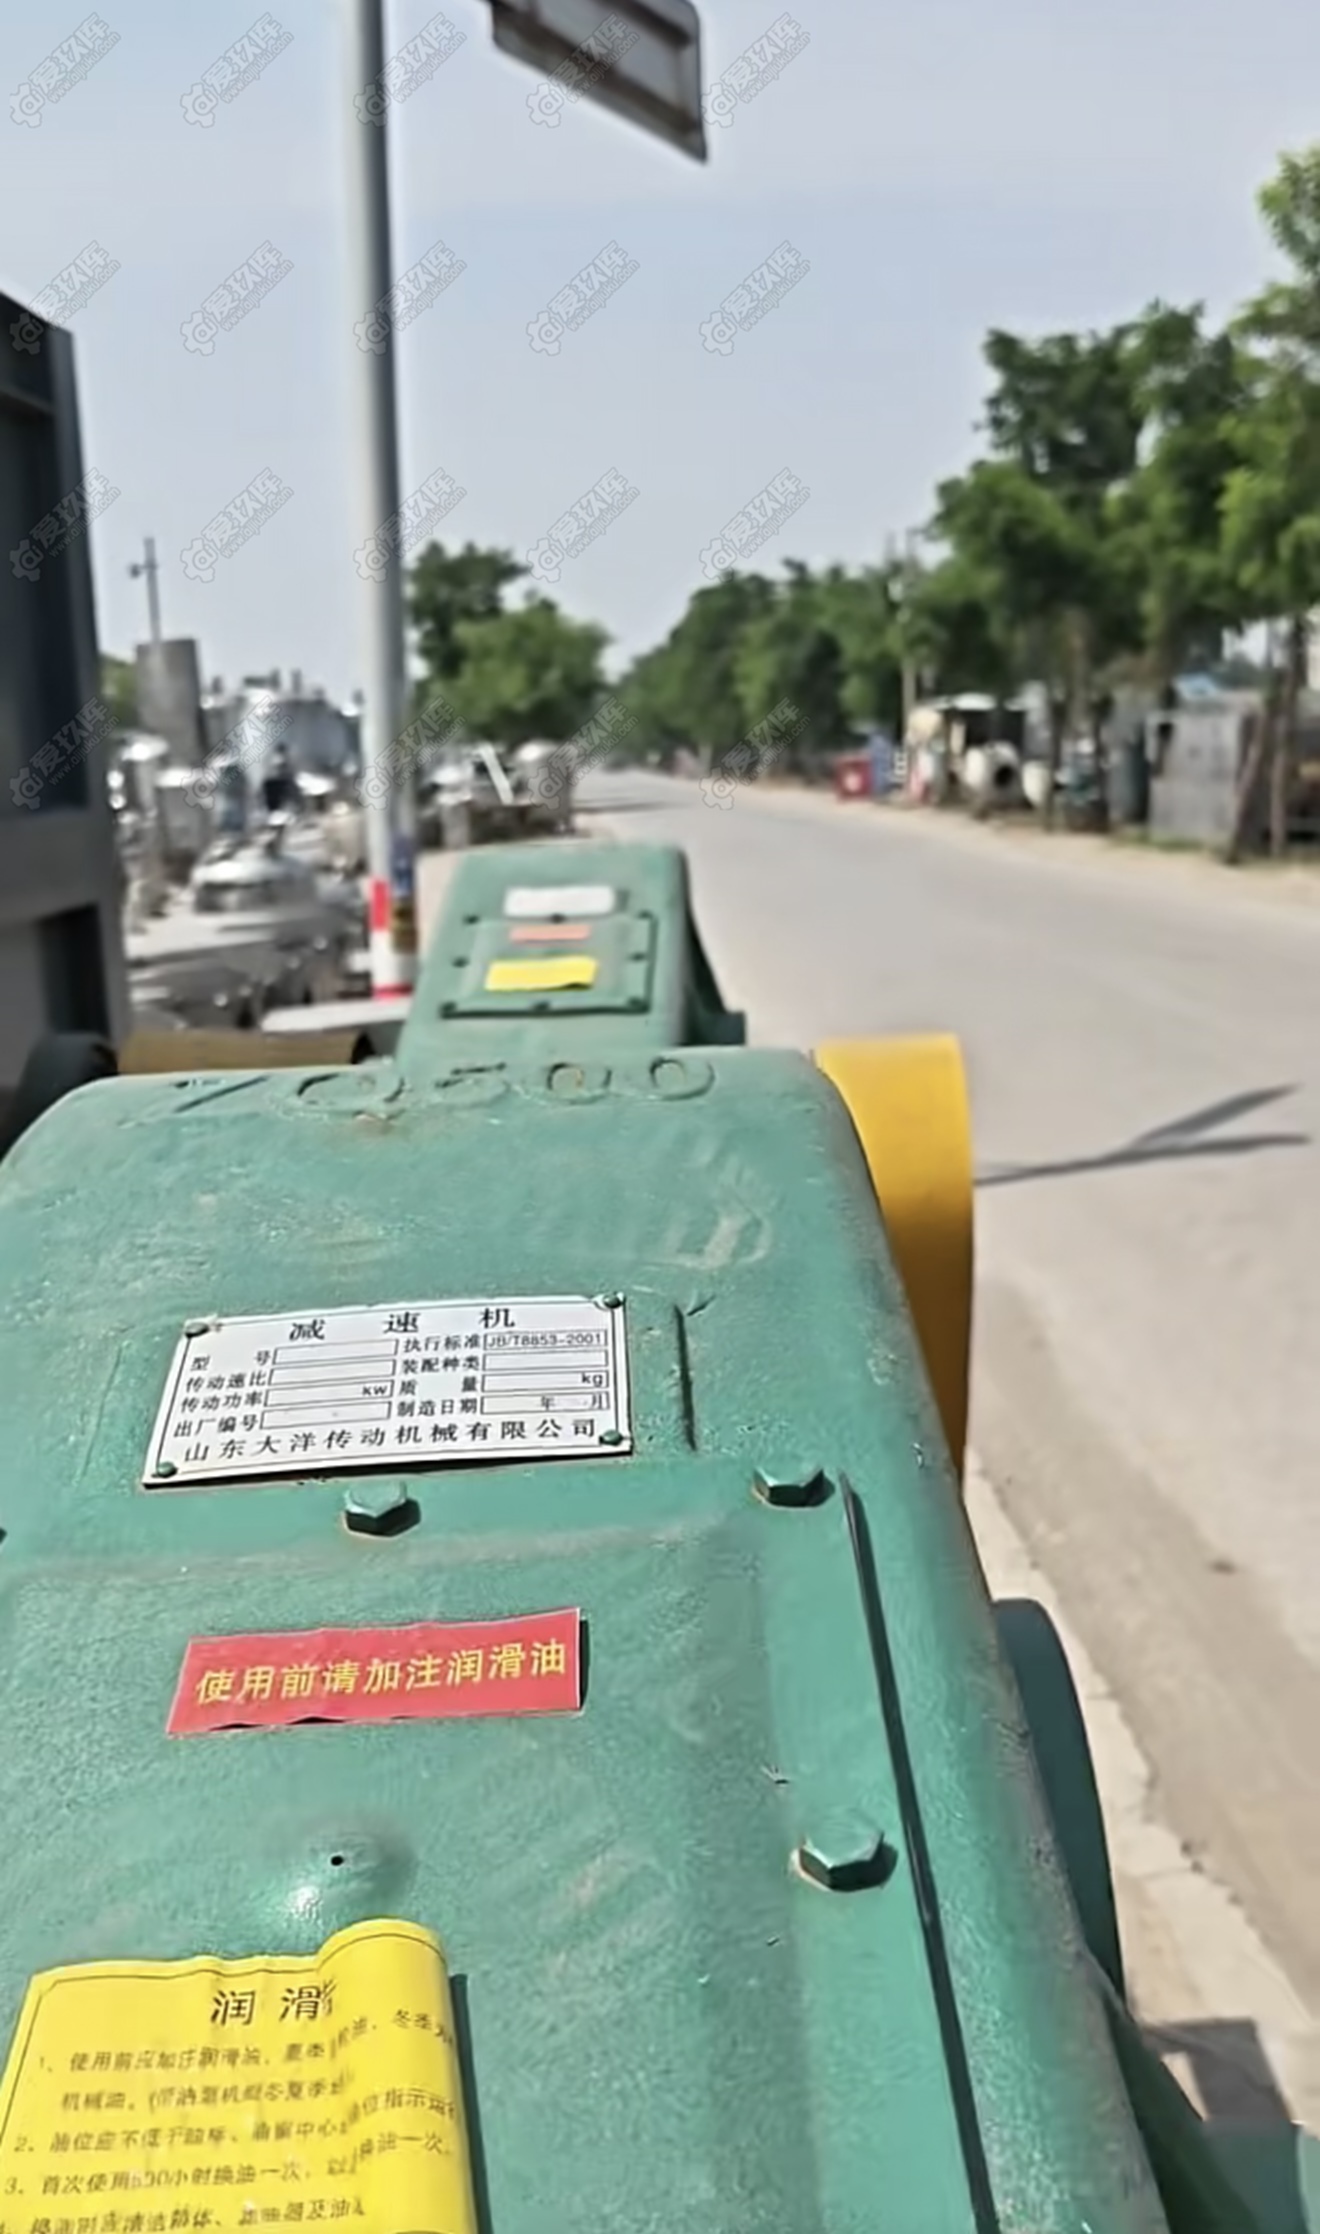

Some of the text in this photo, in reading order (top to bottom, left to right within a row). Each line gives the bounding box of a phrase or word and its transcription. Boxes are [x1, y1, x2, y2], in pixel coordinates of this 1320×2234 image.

[289, 1308, 515, 1341] 减速机
[404, 1333, 480, 1353] 执行标准
[488, 1334, 601, 1348] JB/T8853-2001
[402, 1356, 480, 1375] 装配种类
[186, 1372, 267, 1393] 传动速比
[581, 1372, 604, 1388] kg
[181, 1391, 263, 1413] 传动功率
[397, 1398, 478, 1418] 制造日期
[173, 1414, 258, 1438] 出厂编号
[184, 1419, 595, 1463] 山东大洋传动机械有限公司
[197, 1638, 566, 1703] 使用前请加注润滑油
